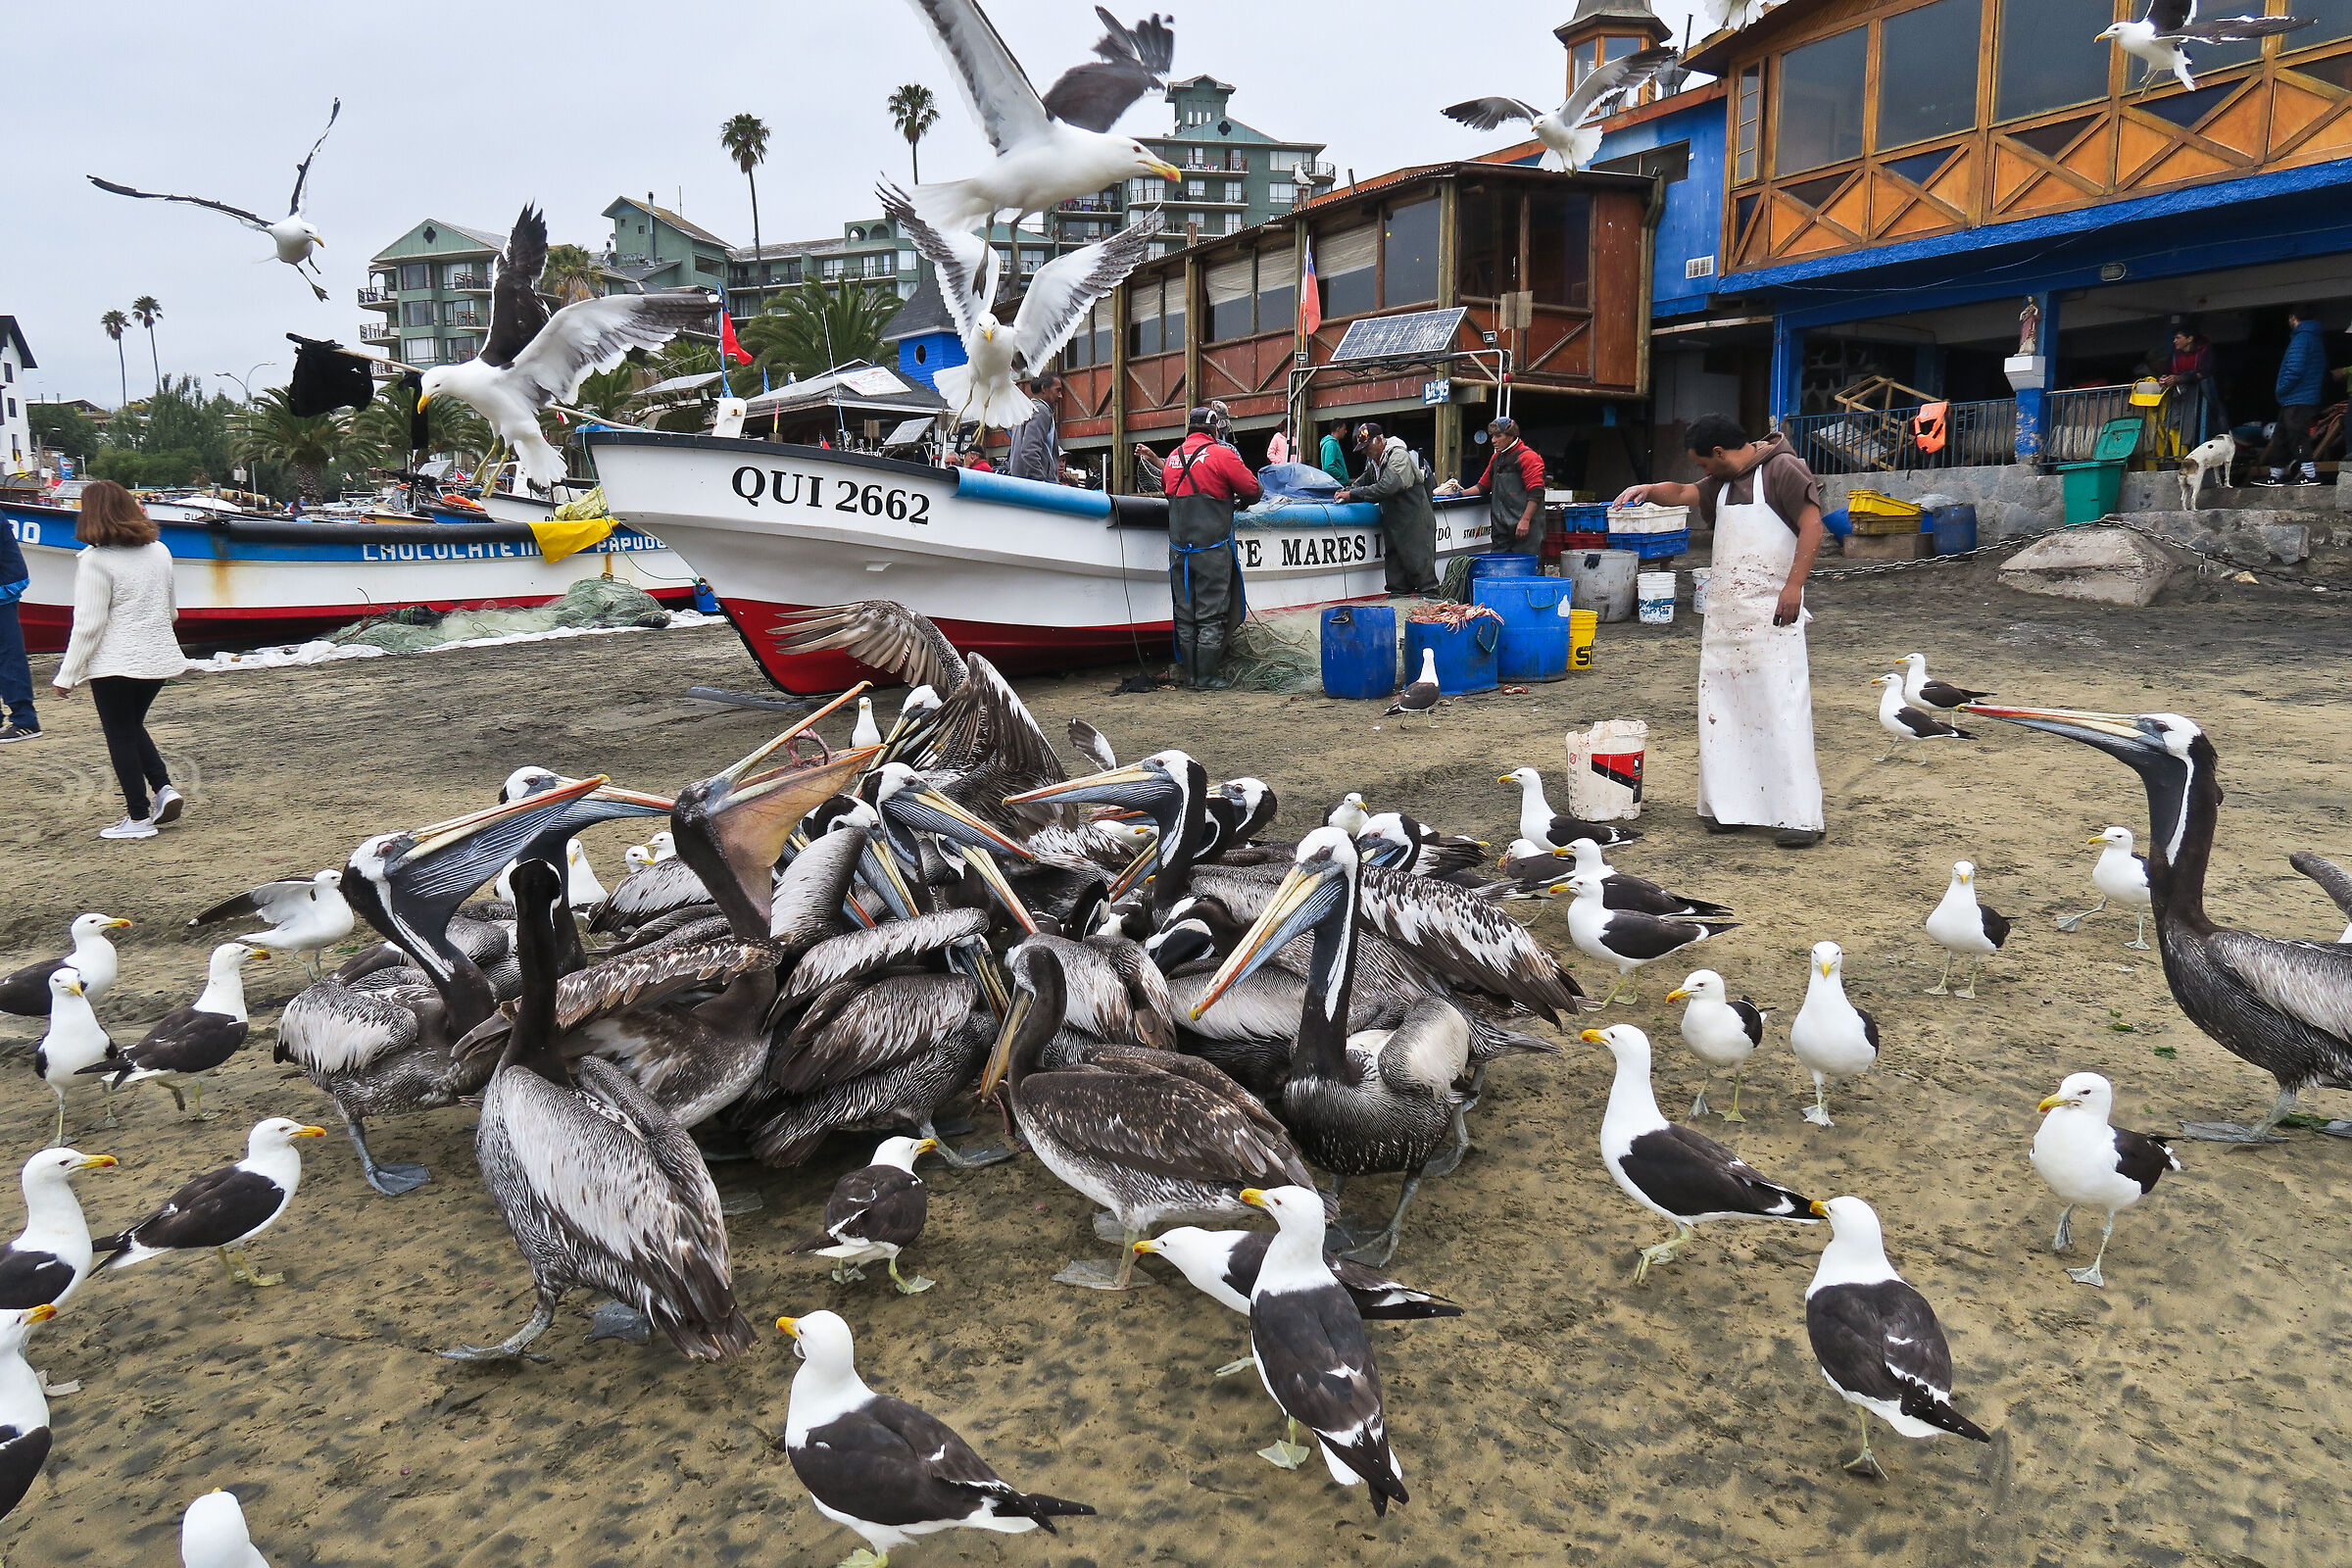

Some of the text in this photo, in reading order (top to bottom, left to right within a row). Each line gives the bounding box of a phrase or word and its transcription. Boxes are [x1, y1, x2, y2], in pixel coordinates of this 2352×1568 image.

[732, 466, 930, 525] QUI 2662
[363, 542, 514, 561] CHOCOLATE
[1281, 534, 1366, 565] MARES
